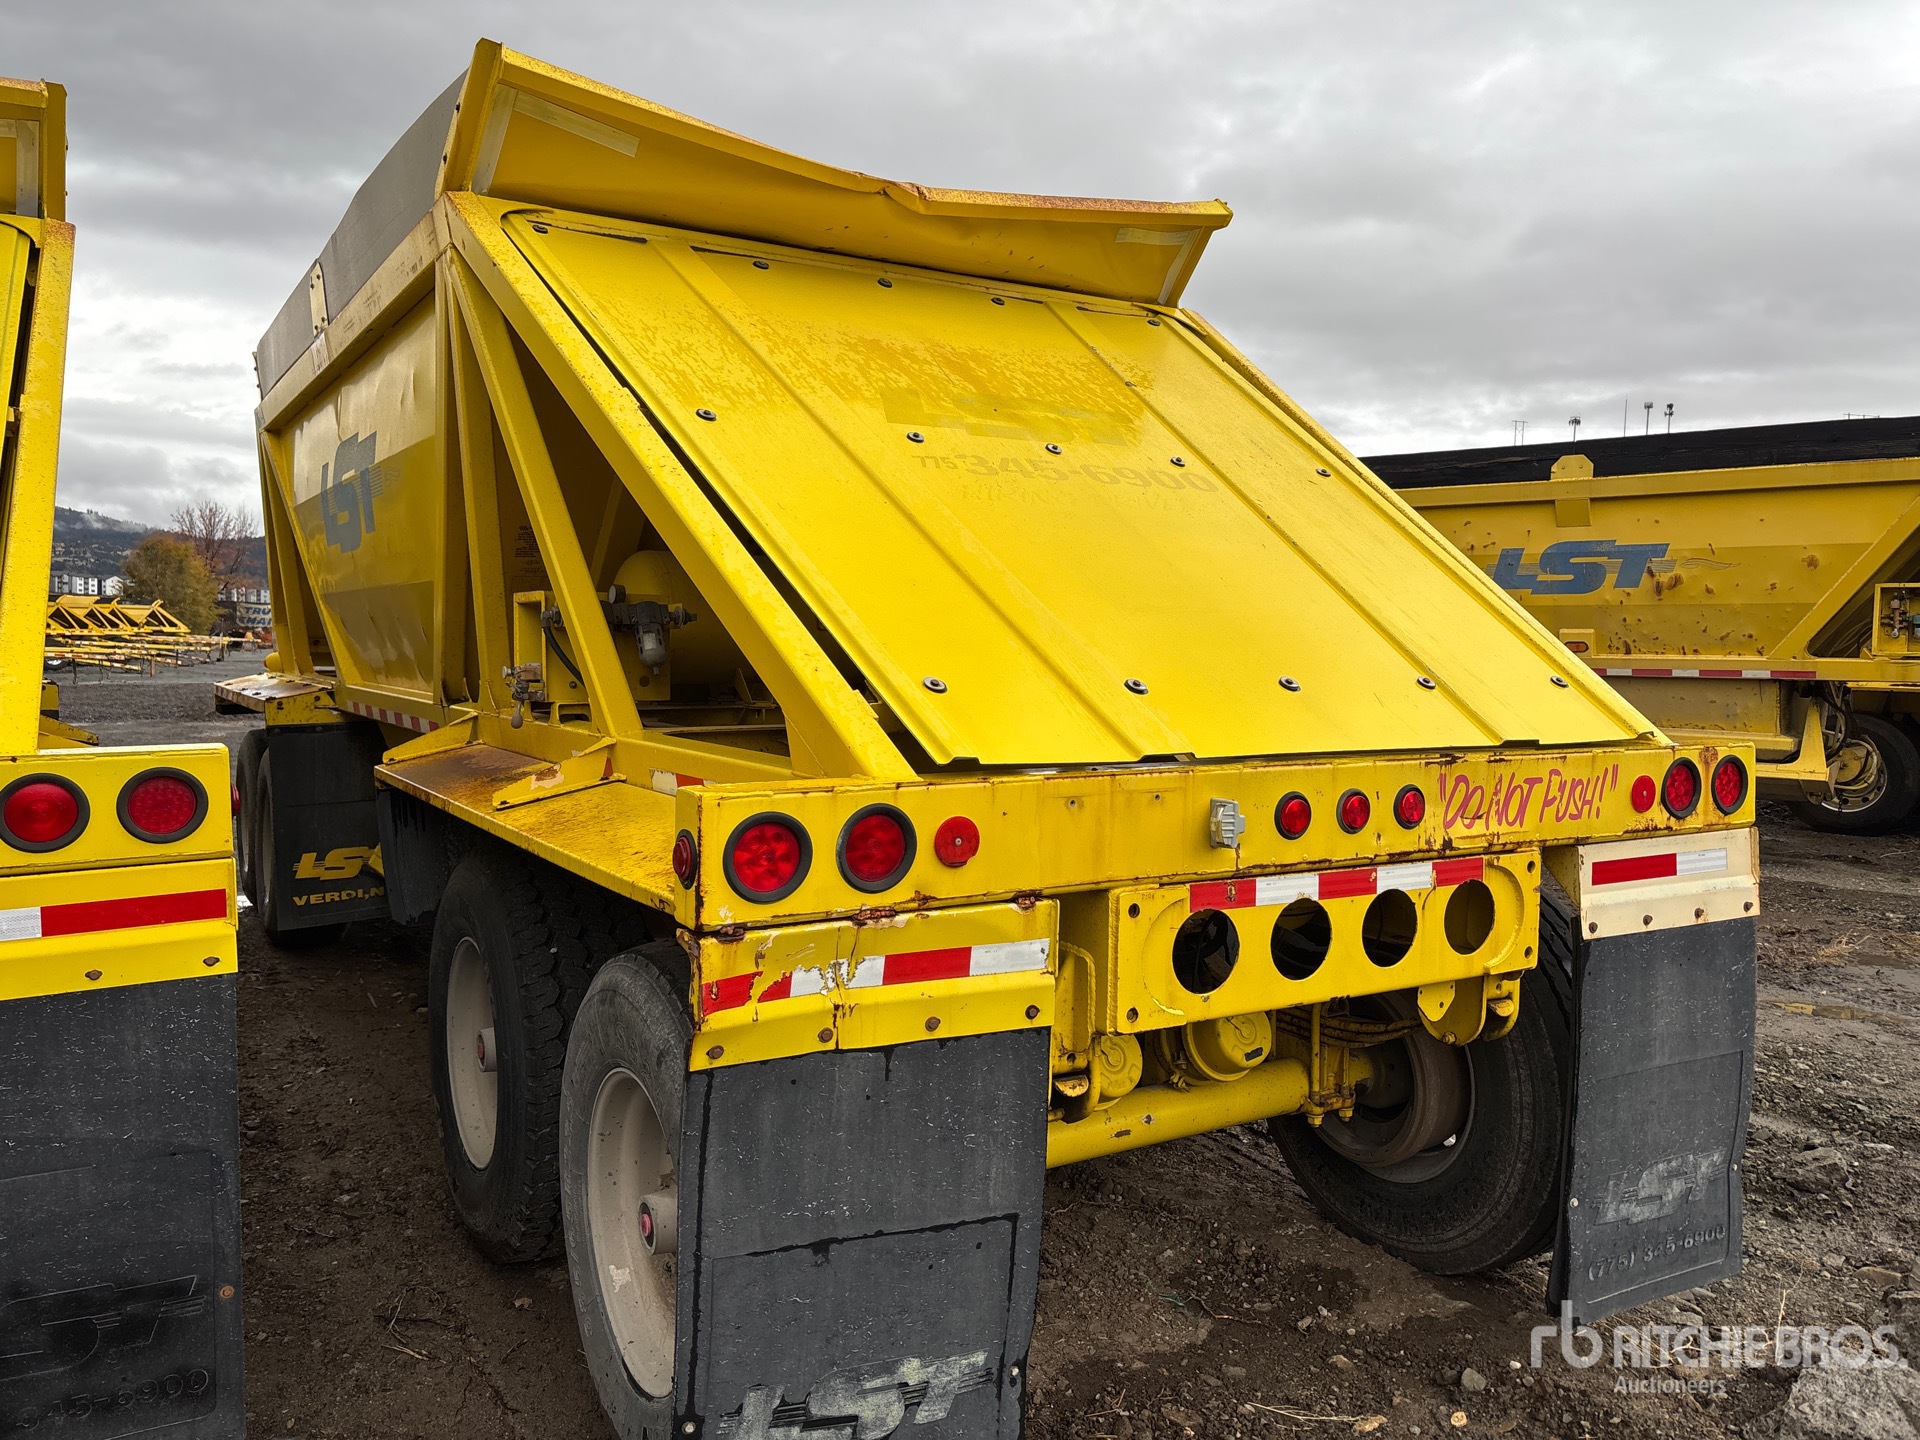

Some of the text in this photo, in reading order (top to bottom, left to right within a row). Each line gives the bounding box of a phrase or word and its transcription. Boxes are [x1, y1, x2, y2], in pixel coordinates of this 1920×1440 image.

[320, 430, 377, 554] LST
[911, 453, 1219, 493] 775 345-6900
[1493, 539, 1671, 595] LST
[245, 607, 271, 615] TRU
[1485, 772, 1543, 831] NOT
[293, 846, 373, 881] LS
[1594, 1150, 1728, 1226] LST
[1588, 1249, 1636, 1281] (775)
[733, 1350, 989, 1440] LST
